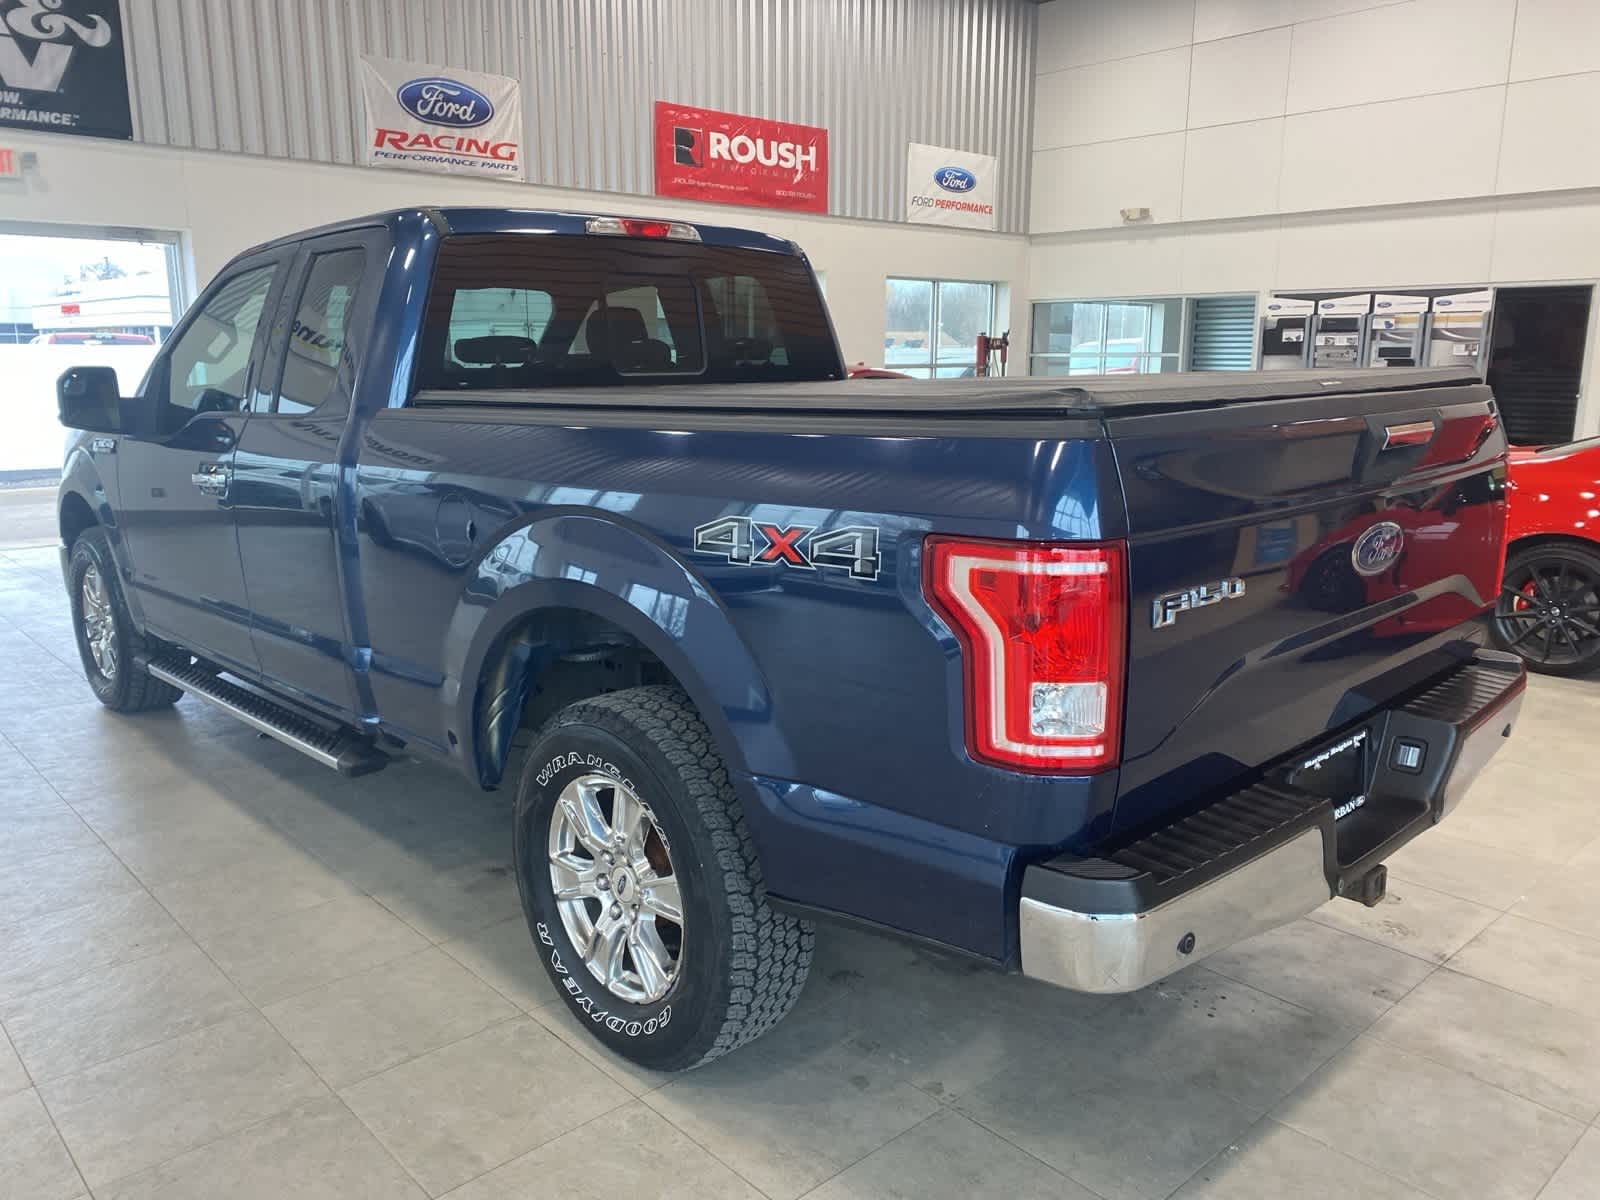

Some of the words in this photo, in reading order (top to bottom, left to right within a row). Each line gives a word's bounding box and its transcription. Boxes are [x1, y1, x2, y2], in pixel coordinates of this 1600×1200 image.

[417, 84, 476, 122] Ford
[374, 128, 518, 161] RACING
[374, 150, 478, 167] PERFORMANCE
[481, 162, 518, 171] PARTS
[709, 131, 817, 184] ROUSH
[942, 170, 968, 189] Ford
[911, 196, 934, 207] FORD
[935, 198, 993, 215] PERFORMANCE
[536, 921, 672, 1037] GOODYEAR
